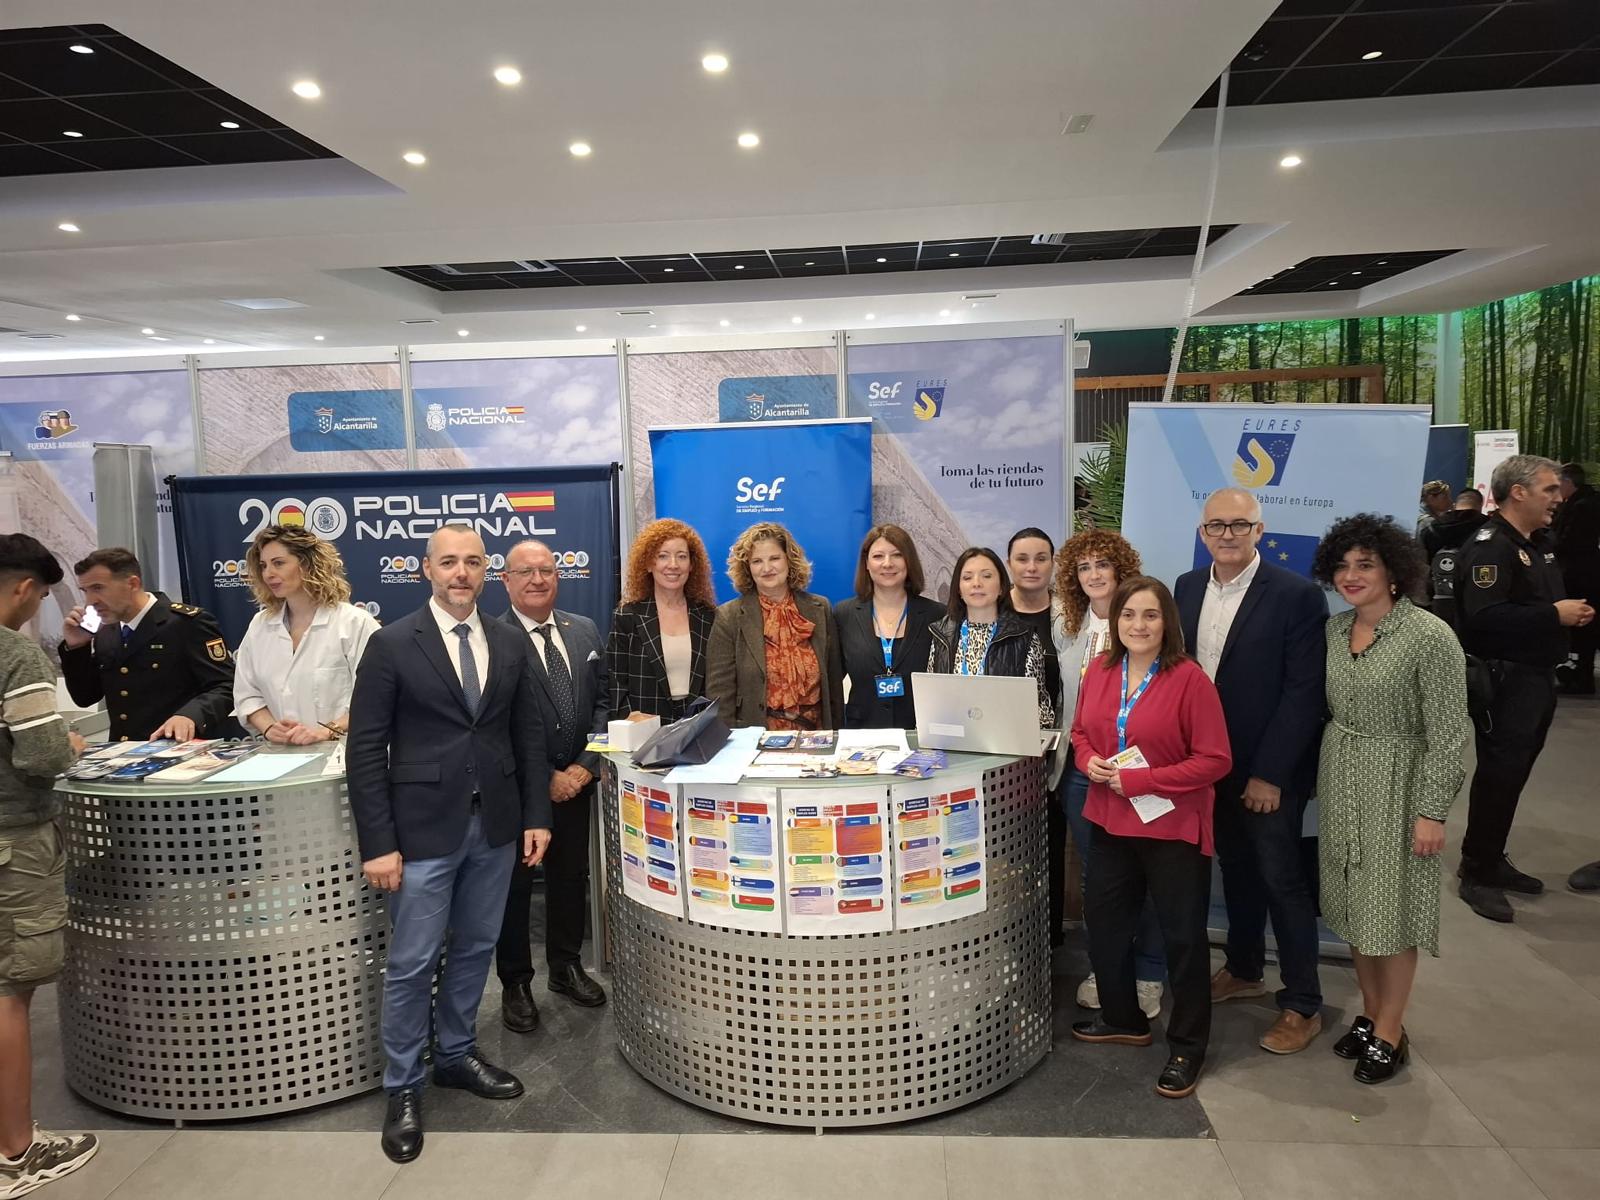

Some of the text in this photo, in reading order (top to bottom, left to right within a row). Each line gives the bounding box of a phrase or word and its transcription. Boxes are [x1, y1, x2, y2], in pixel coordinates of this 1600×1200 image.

[868, 381, 902, 399] Sef
[764, 408, 810, 417] Alcantarilla
[333, 421, 378, 430] Alcantarilla
[449, 415, 526, 425] NACIONAL
[1242, 418, 1302, 432] EURES
[28, 442, 57, 450] FUERZAS
[940, 461, 1044, 477] Toma las riendas
[735, 476, 785, 502] Sef
[969, 475, 1044, 489] de tu futuro
[1191, 490, 1200, 500] Tu
[1256, 493, 1334, 508] laboral en Europa
[379, 555, 420, 572] 200
[879, 681, 901, 694] Sef
